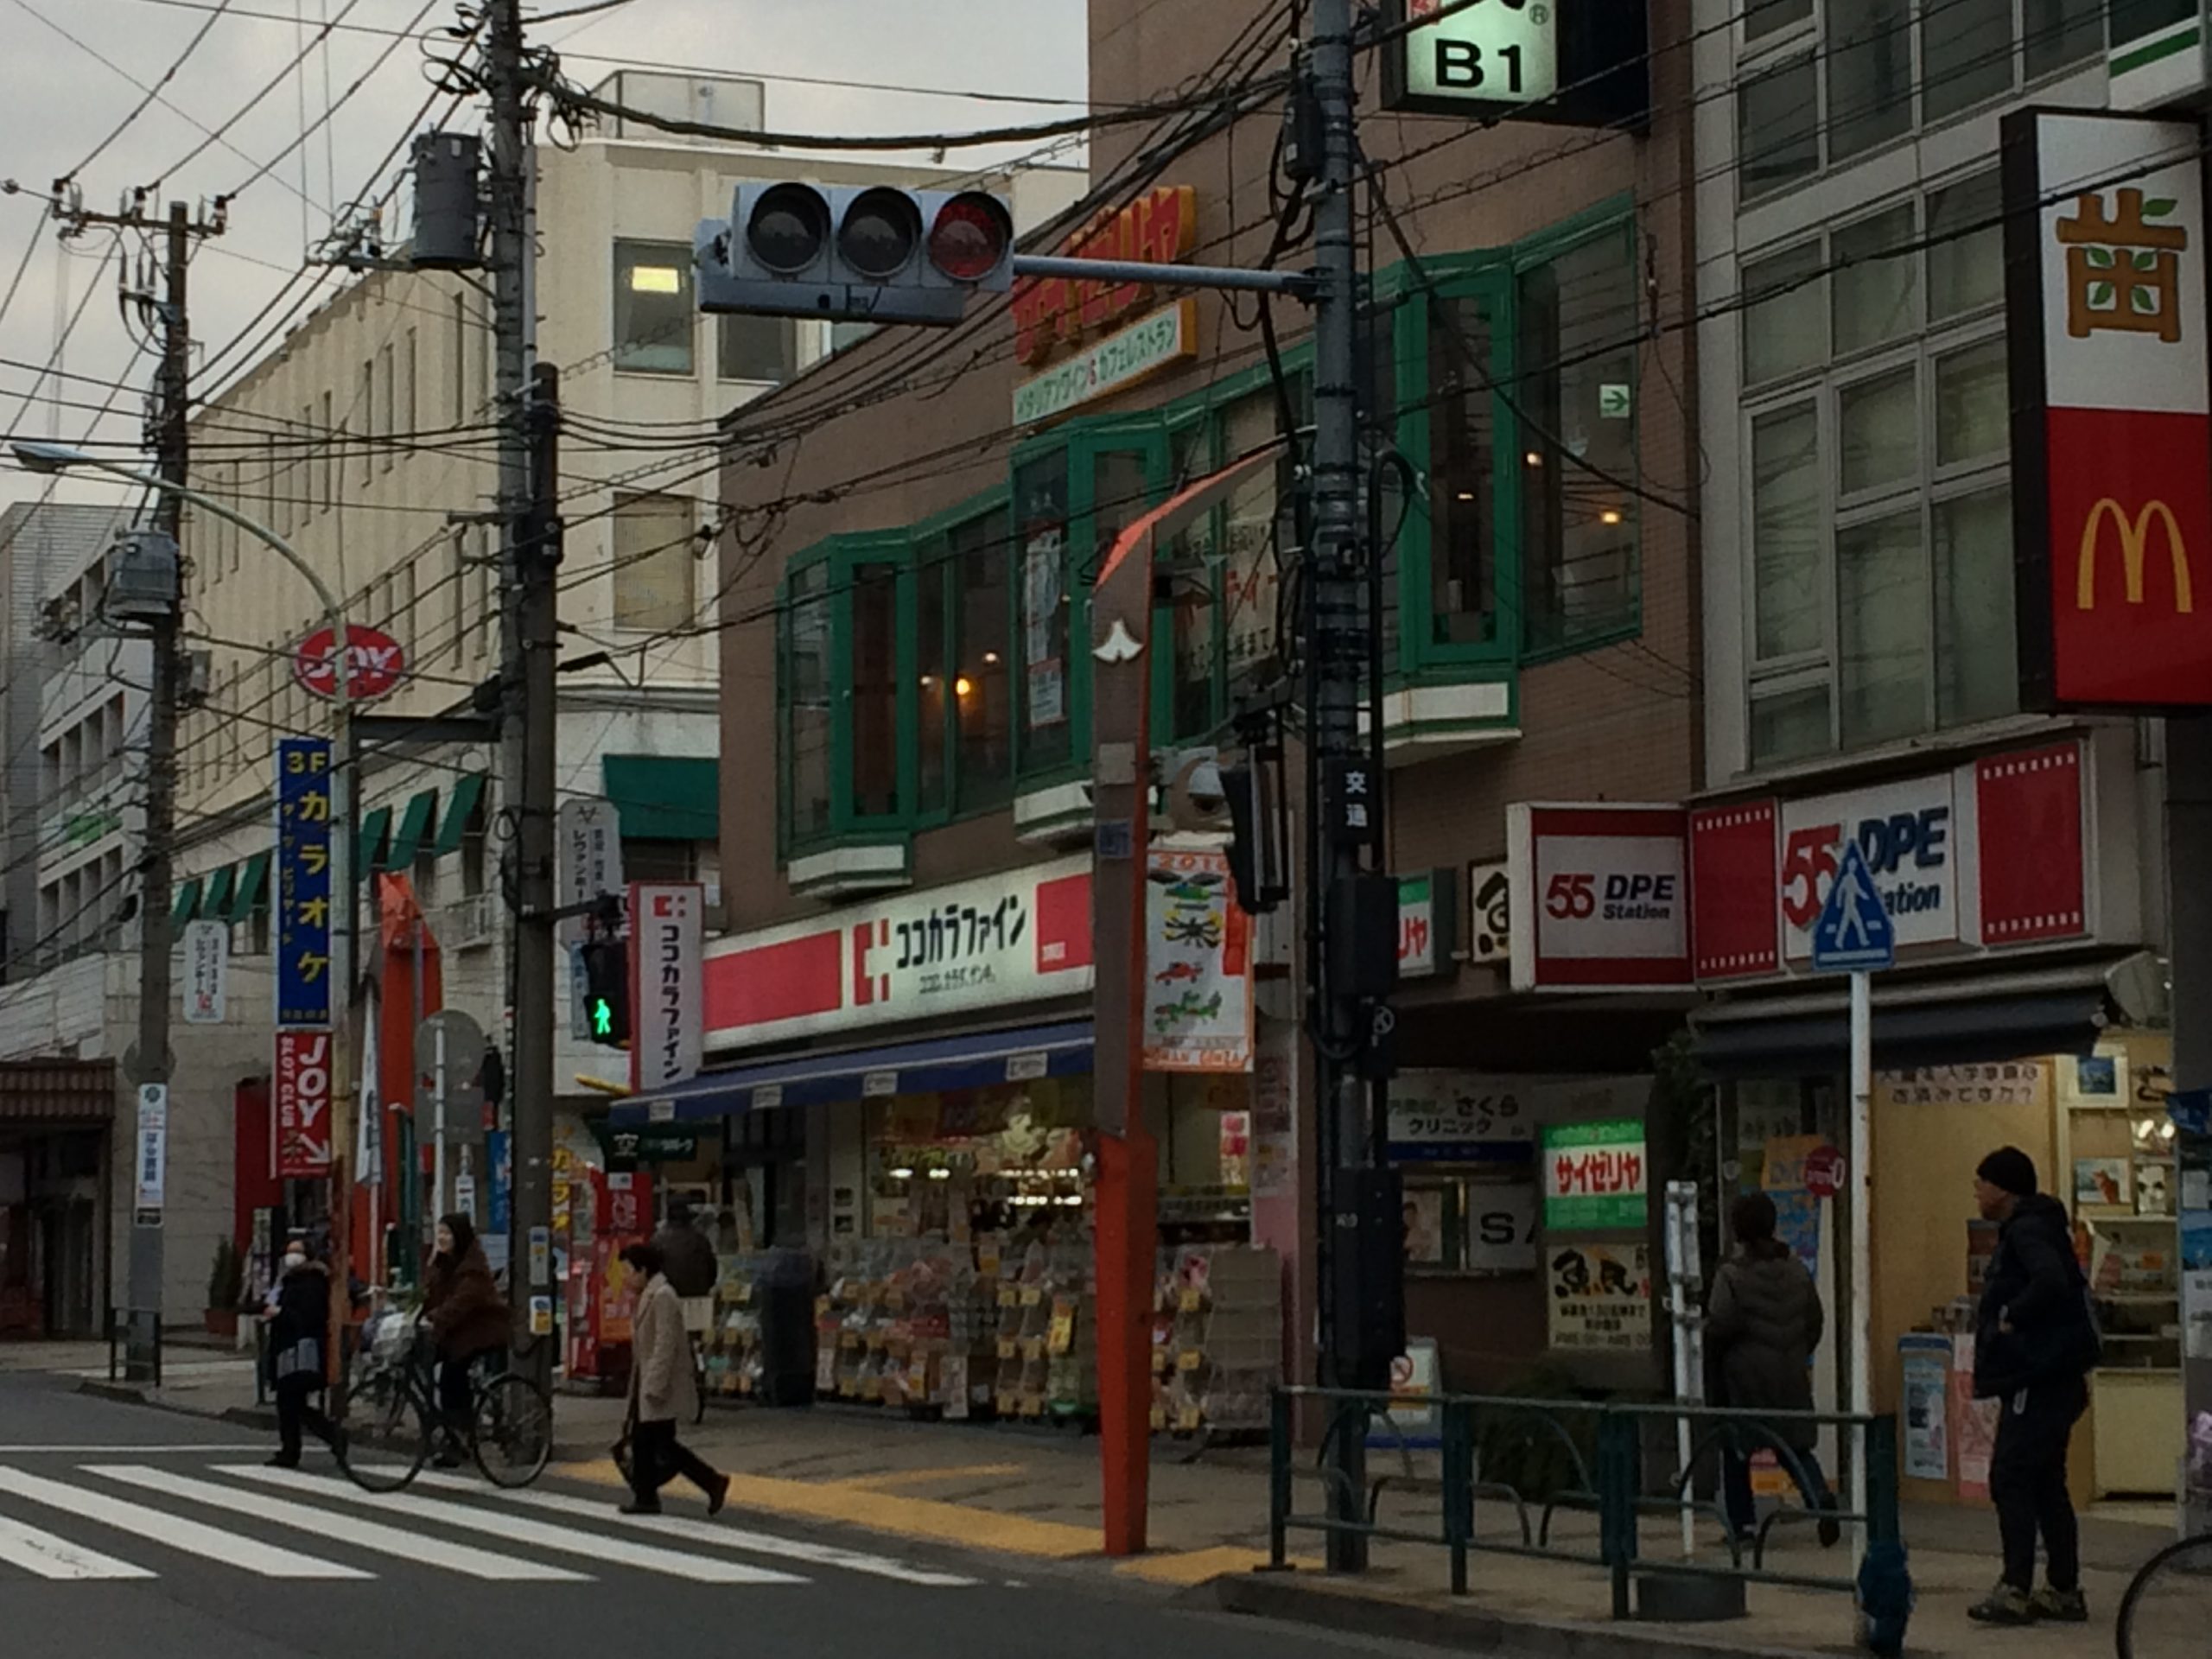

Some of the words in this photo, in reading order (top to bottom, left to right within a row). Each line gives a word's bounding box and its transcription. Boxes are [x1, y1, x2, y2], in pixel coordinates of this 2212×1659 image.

[1434, 38, 1522, 93] B1
[286, 750, 328, 775] 3F
[296, 789, 329, 983] カラオケ
[1783, 823, 1841, 928] 55
[1859, 805, 1949, 874] DPE
[1545, 874, 1597, 919] 55
[1605, 874, 1675, 900] DPE
[1603, 904, 1670, 920] Station
[1880, 880, 1941, 917] ation
[895, 894, 1027, 969] ココカラファイン
[660, 925, 683, 1081] ココカラファイン
[296, 1035, 327, 1128] JOY
[1408, 1117, 1492, 1135] クリニック
[1556, 1151, 1642, 1194] サイゼリヤ
